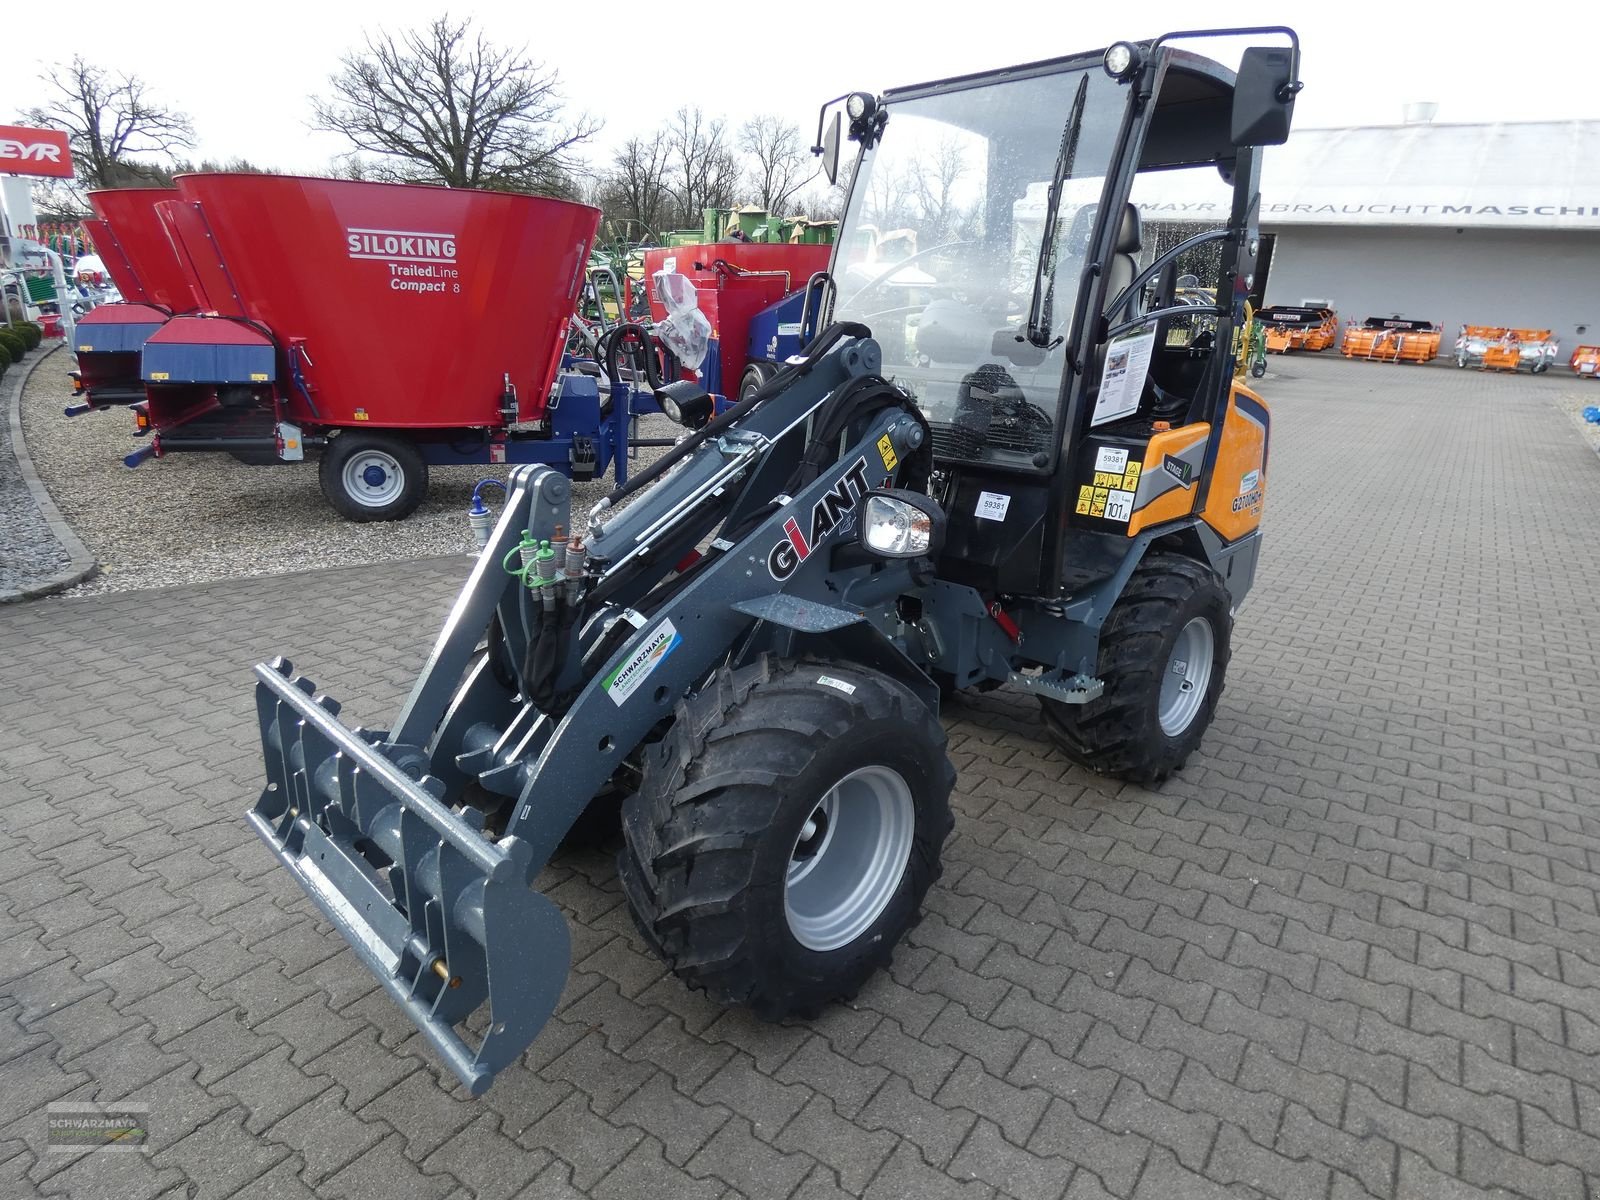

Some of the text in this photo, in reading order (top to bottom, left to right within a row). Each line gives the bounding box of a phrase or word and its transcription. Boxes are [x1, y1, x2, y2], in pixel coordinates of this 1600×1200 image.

[348, 234, 456, 257] SILOKING
[391, 279, 461, 294] Compact 8
[1103, 455, 1124, 464] 59381
[1166, 461, 1182, 478] STAGE
[983, 500, 1005, 510] 59381
[1108, 503, 1123, 518] 101
[613, 633, 665, 688] SCHWARZMAYR
